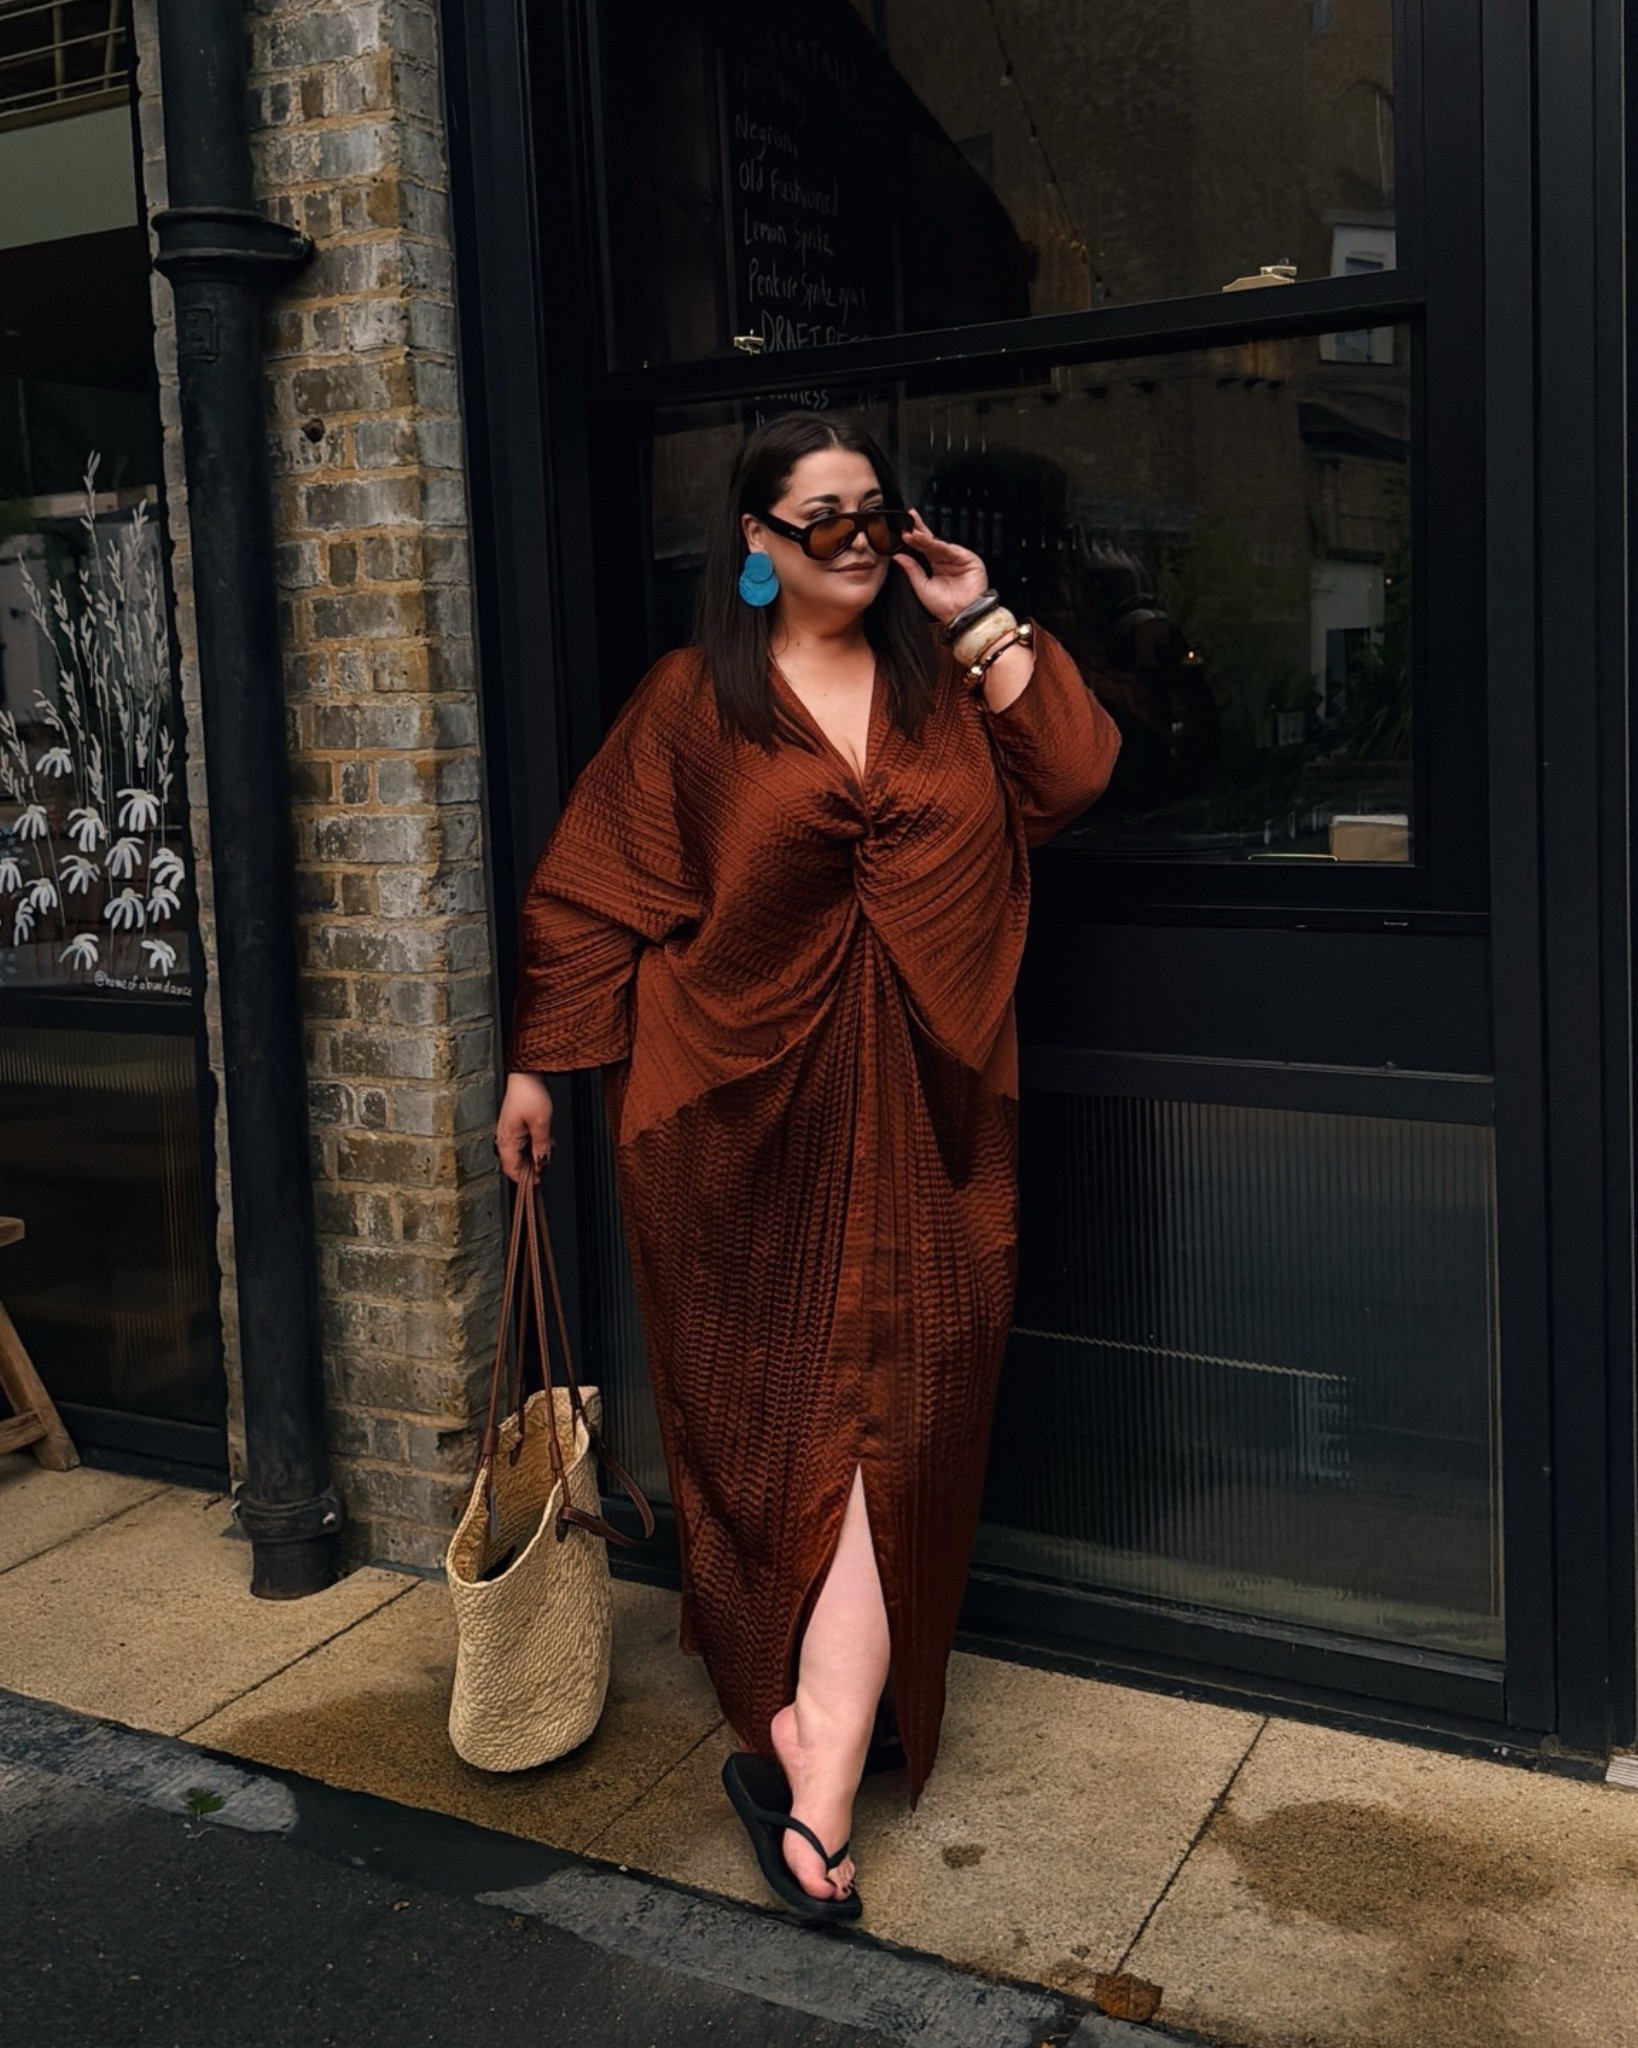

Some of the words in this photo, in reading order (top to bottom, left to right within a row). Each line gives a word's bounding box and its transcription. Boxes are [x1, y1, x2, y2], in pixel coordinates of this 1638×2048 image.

[738, 159, 764, 193] Old
[744, 207, 788, 247] Lemon
[794, 217, 836, 269] Spritz
[798, 270, 838, 313] Spritz
